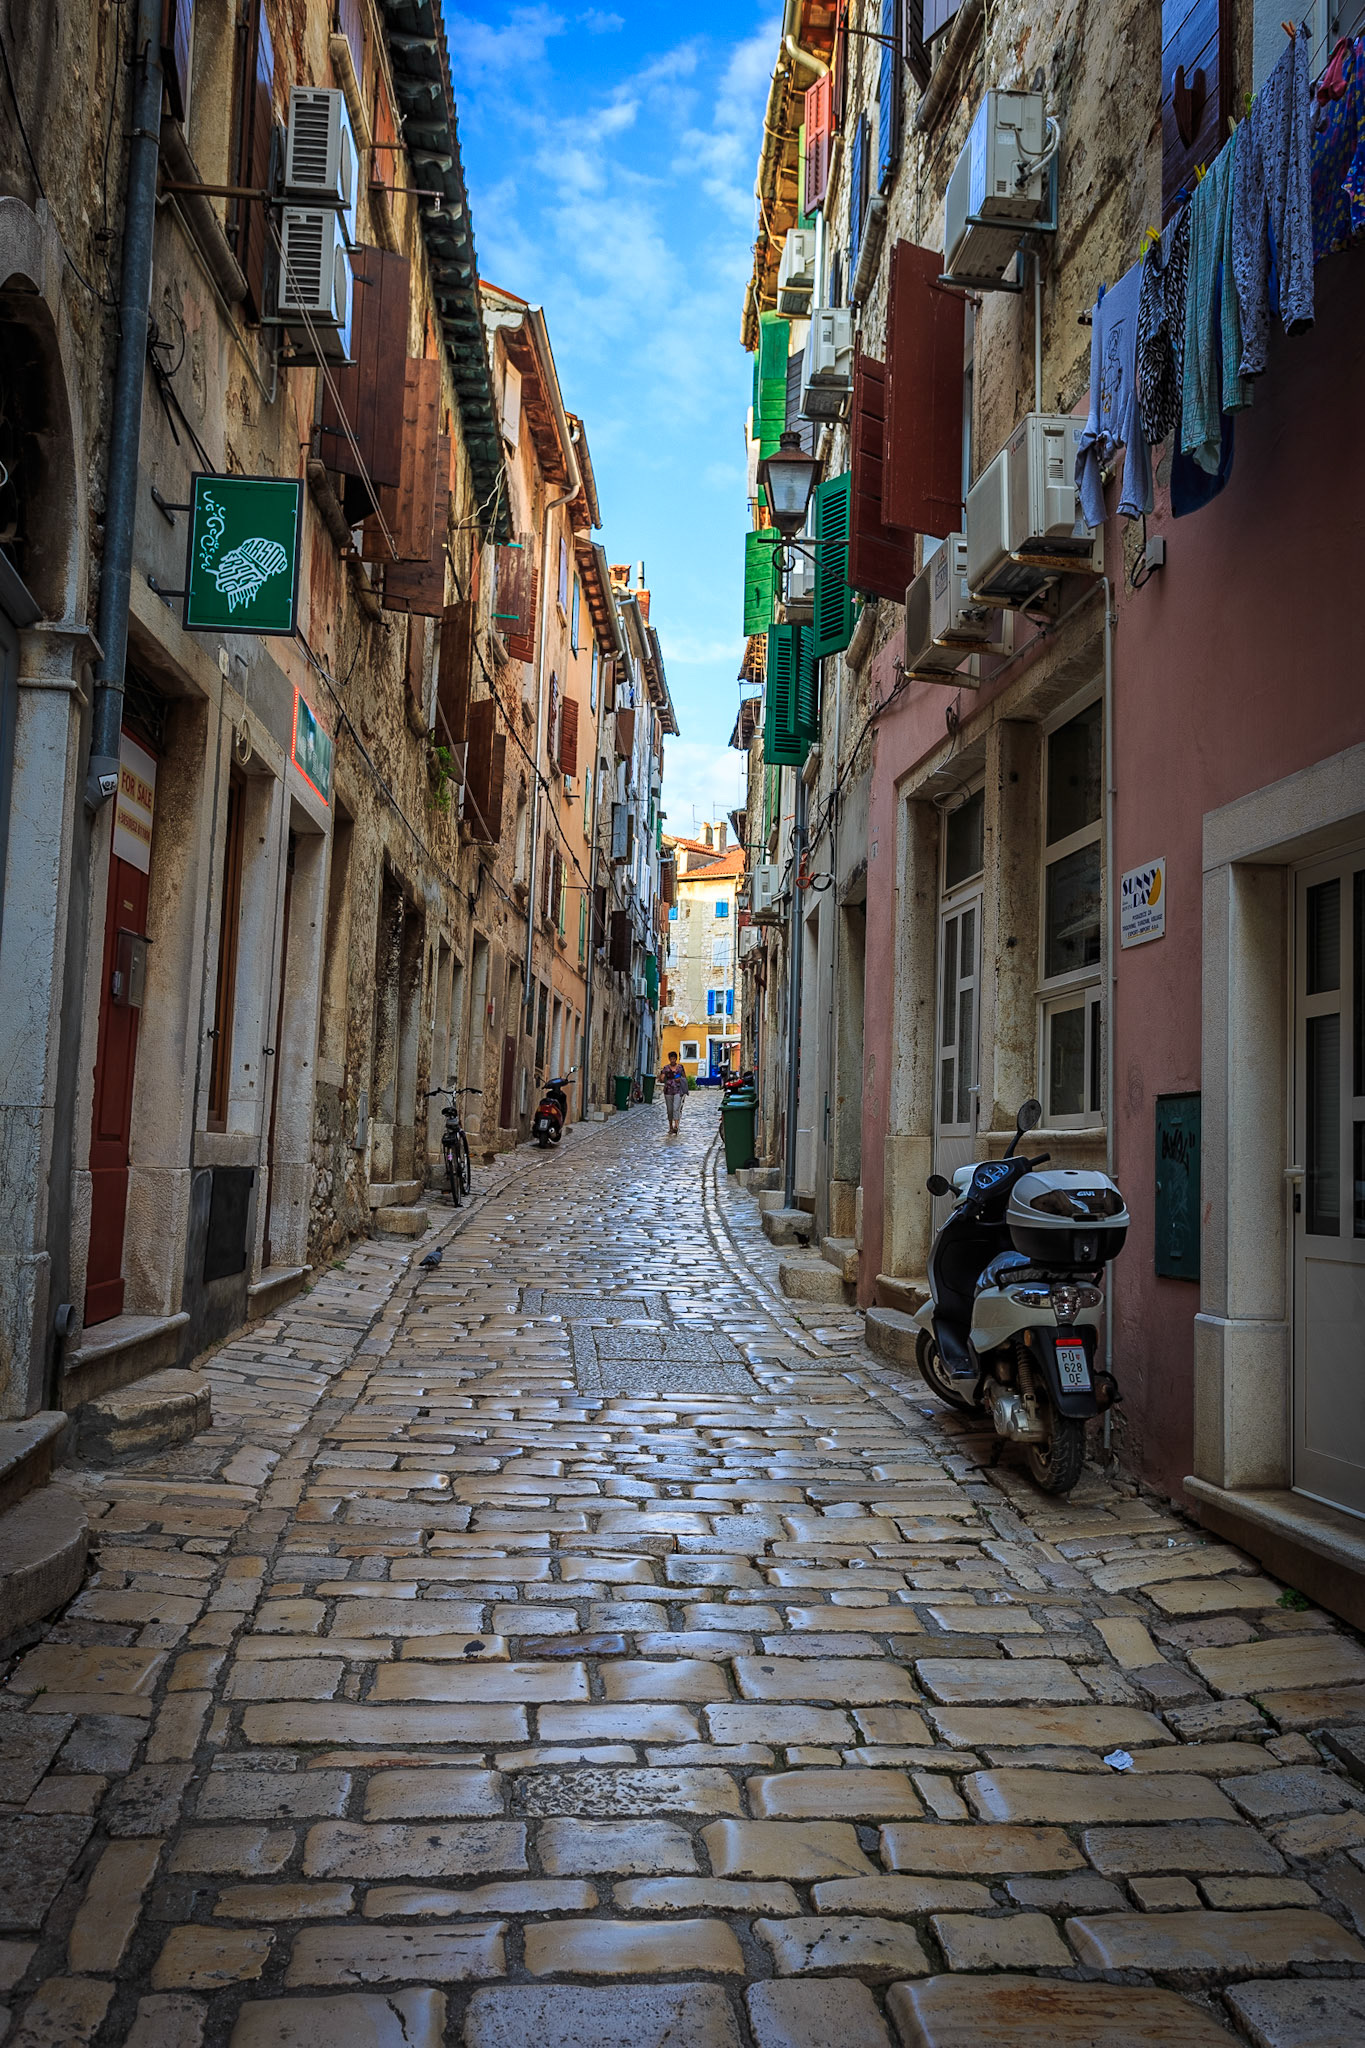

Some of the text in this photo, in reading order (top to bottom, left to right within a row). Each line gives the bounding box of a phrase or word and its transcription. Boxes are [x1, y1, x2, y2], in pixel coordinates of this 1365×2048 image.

[121, 770, 153, 808] FOR SALE
[1123, 869, 1157, 897] SUNNY
[1133, 889, 1151, 908] DAY
[1064, 1362, 1083, 1373] 628
